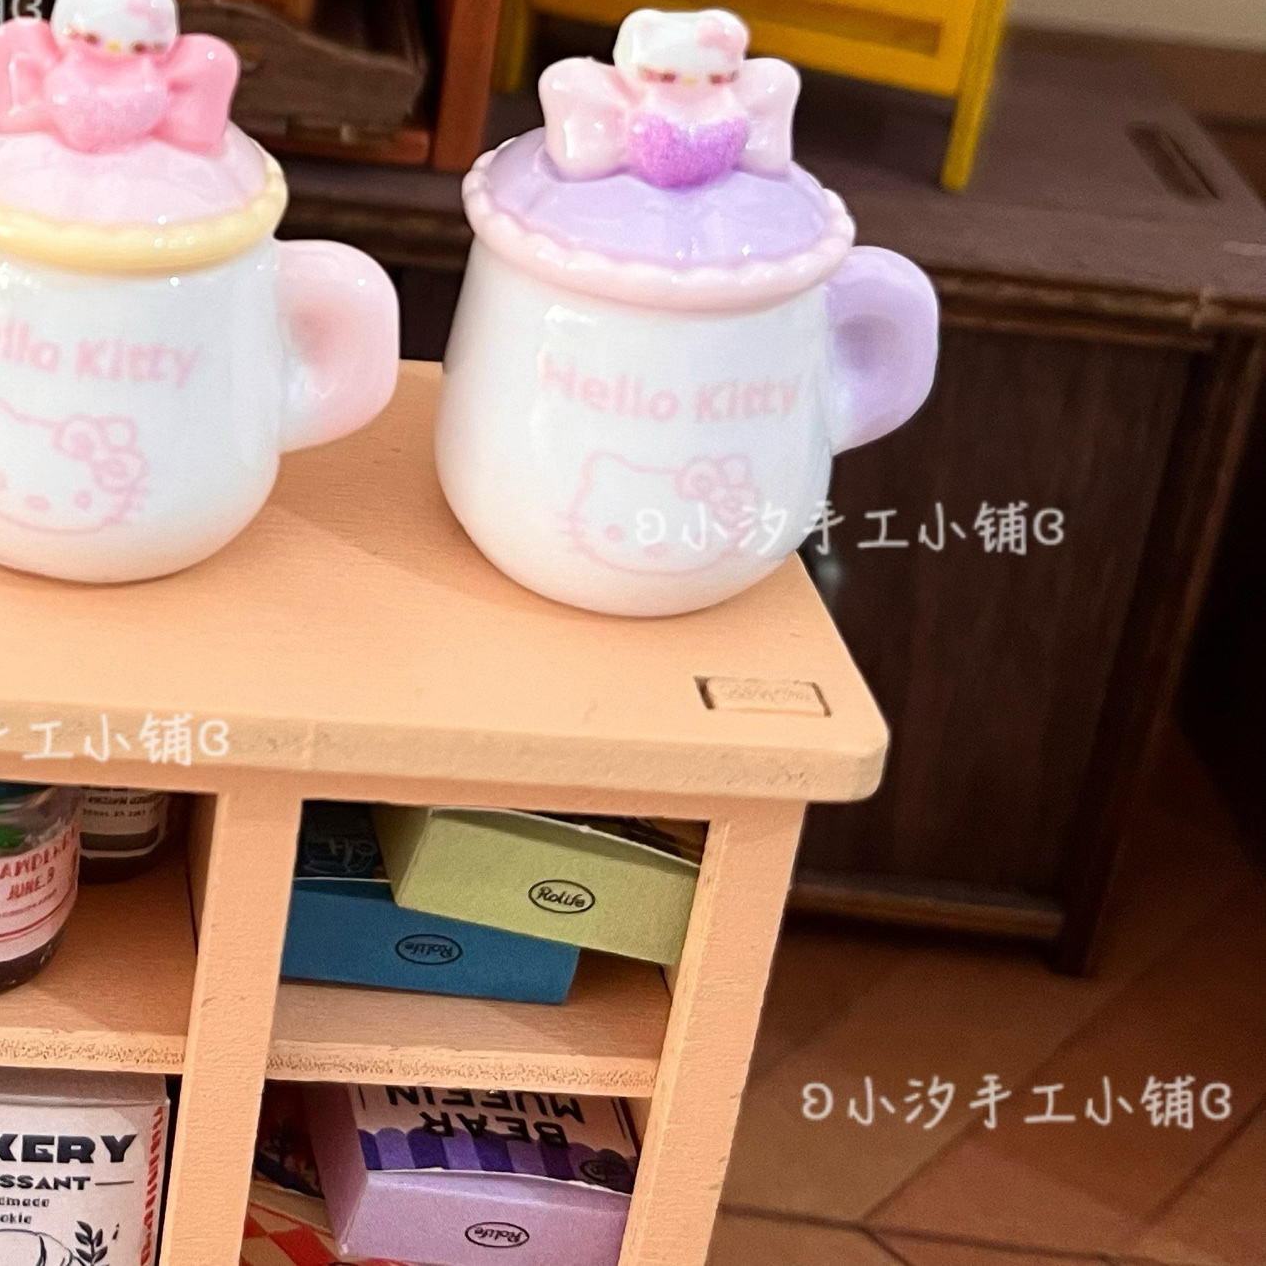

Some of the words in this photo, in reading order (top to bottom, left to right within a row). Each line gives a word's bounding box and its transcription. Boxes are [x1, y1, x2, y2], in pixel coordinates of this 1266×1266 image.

[72, 337, 202, 389] Kitty
[537, 350, 680, 424] Hello
[692, 373, 803, 425] Kitty
[536, 886, 585, 907] Rolife
[420, 1111, 569, 1147] BEAR
